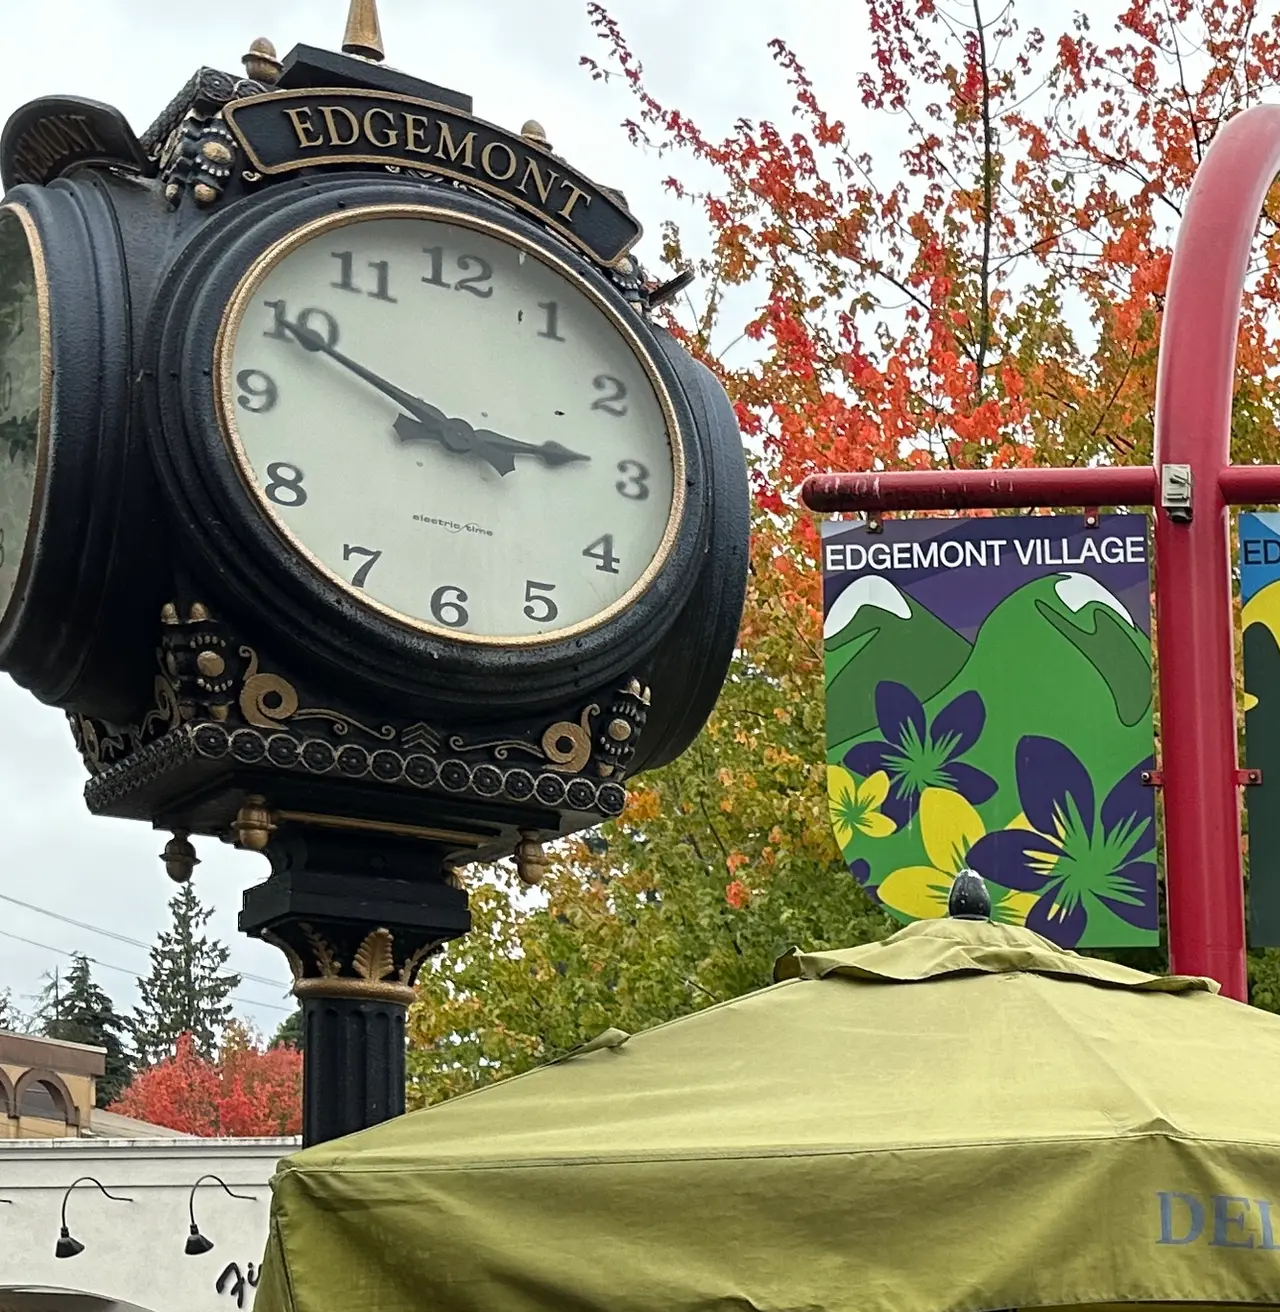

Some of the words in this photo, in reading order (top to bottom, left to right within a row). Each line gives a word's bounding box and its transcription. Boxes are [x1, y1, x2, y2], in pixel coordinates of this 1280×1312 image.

[284, 105, 591, 223] EDGEMONT
[330, 250, 398, 303] 11
[421, 246, 494, 298] 12
[262, 300, 340, 352] 10
[538, 302, 566, 341] 1
[236, 369, 278, 413] 9
[591, 373, 628, 417] 2
[265, 462, 308, 506] 8
[615, 459, 650, 501] 3
[412, 514, 461, 530] electric
[465, 524, 494, 536] time
[343, 543, 382, 587] 7
[582, 533, 620, 573] 4
[826, 540, 1006, 571] EDGEMONT
[1014, 536, 1145, 566] VILLAGE
[430, 586, 468, 627] 6
[523, 581, 558, 622] 5
